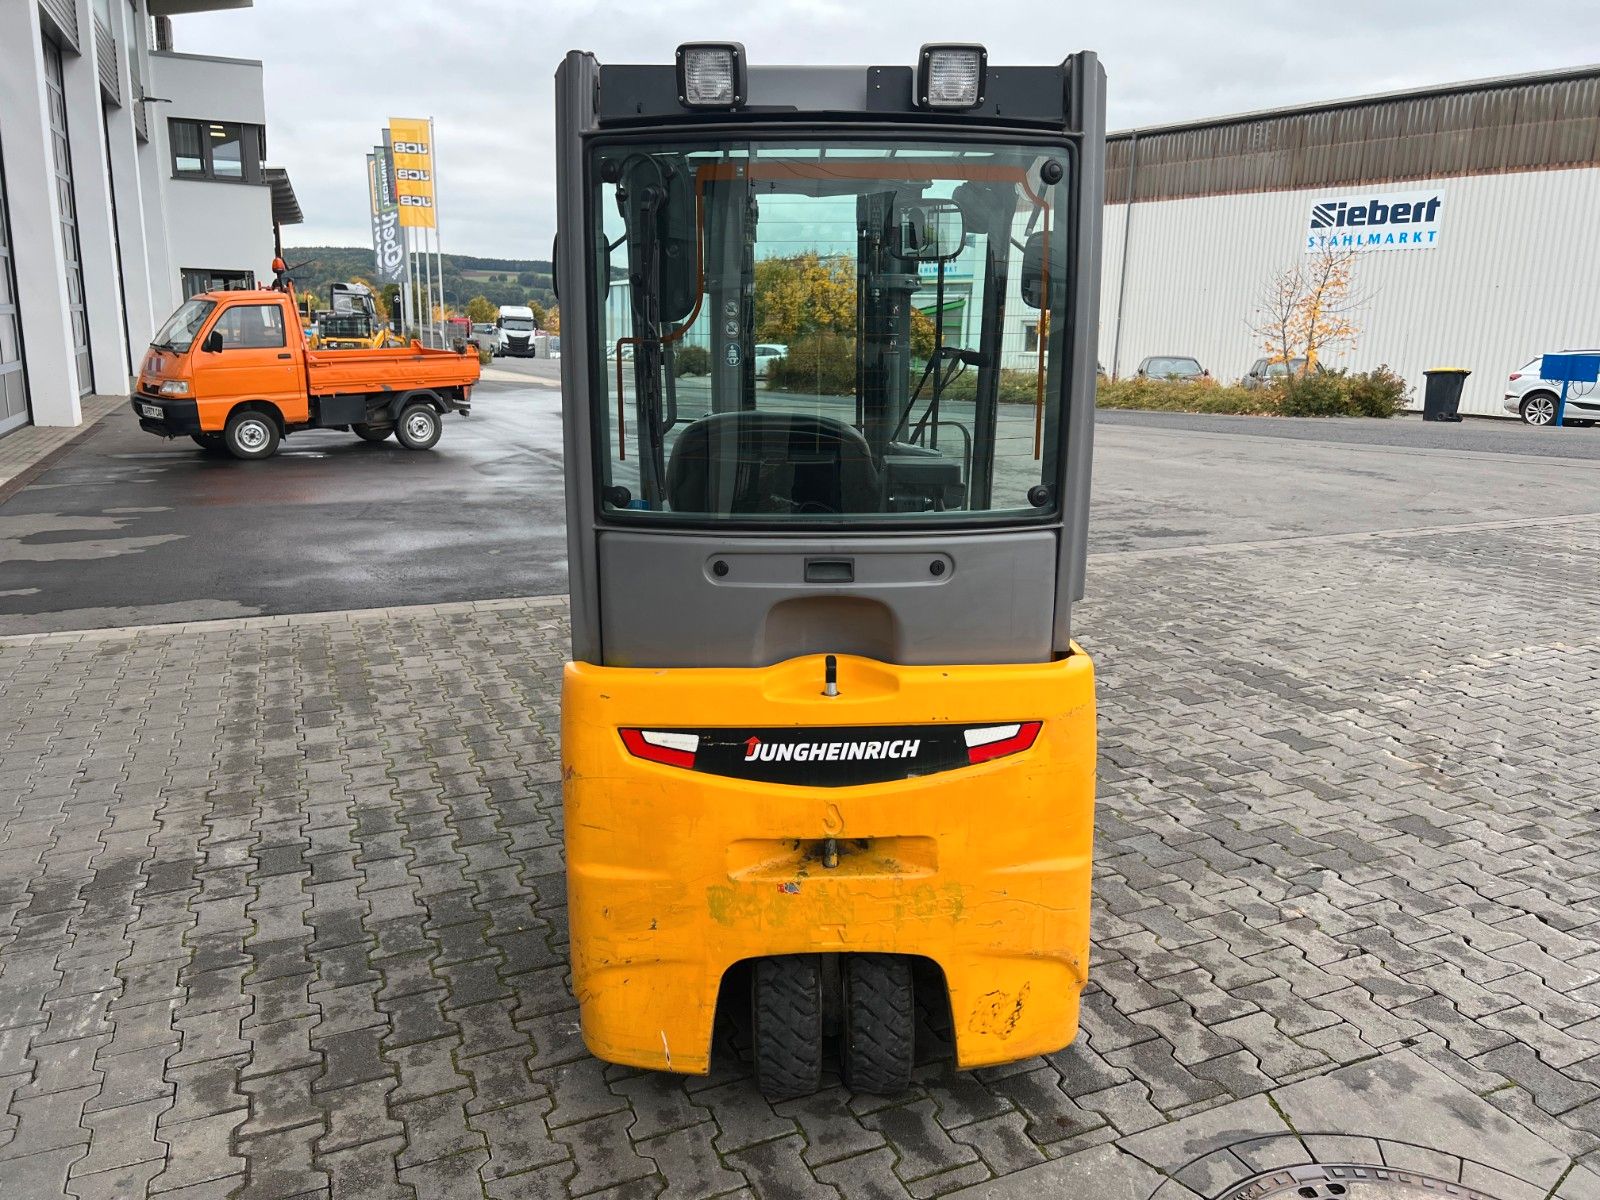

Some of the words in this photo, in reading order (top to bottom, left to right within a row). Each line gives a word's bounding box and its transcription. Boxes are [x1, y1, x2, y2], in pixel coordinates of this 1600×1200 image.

[1311, 196, 1441, 228] Siebert
[1308, 231, 1437, 248] STAHLMARKT
[744, 738, 920, 762] JUNGHEINRICH
